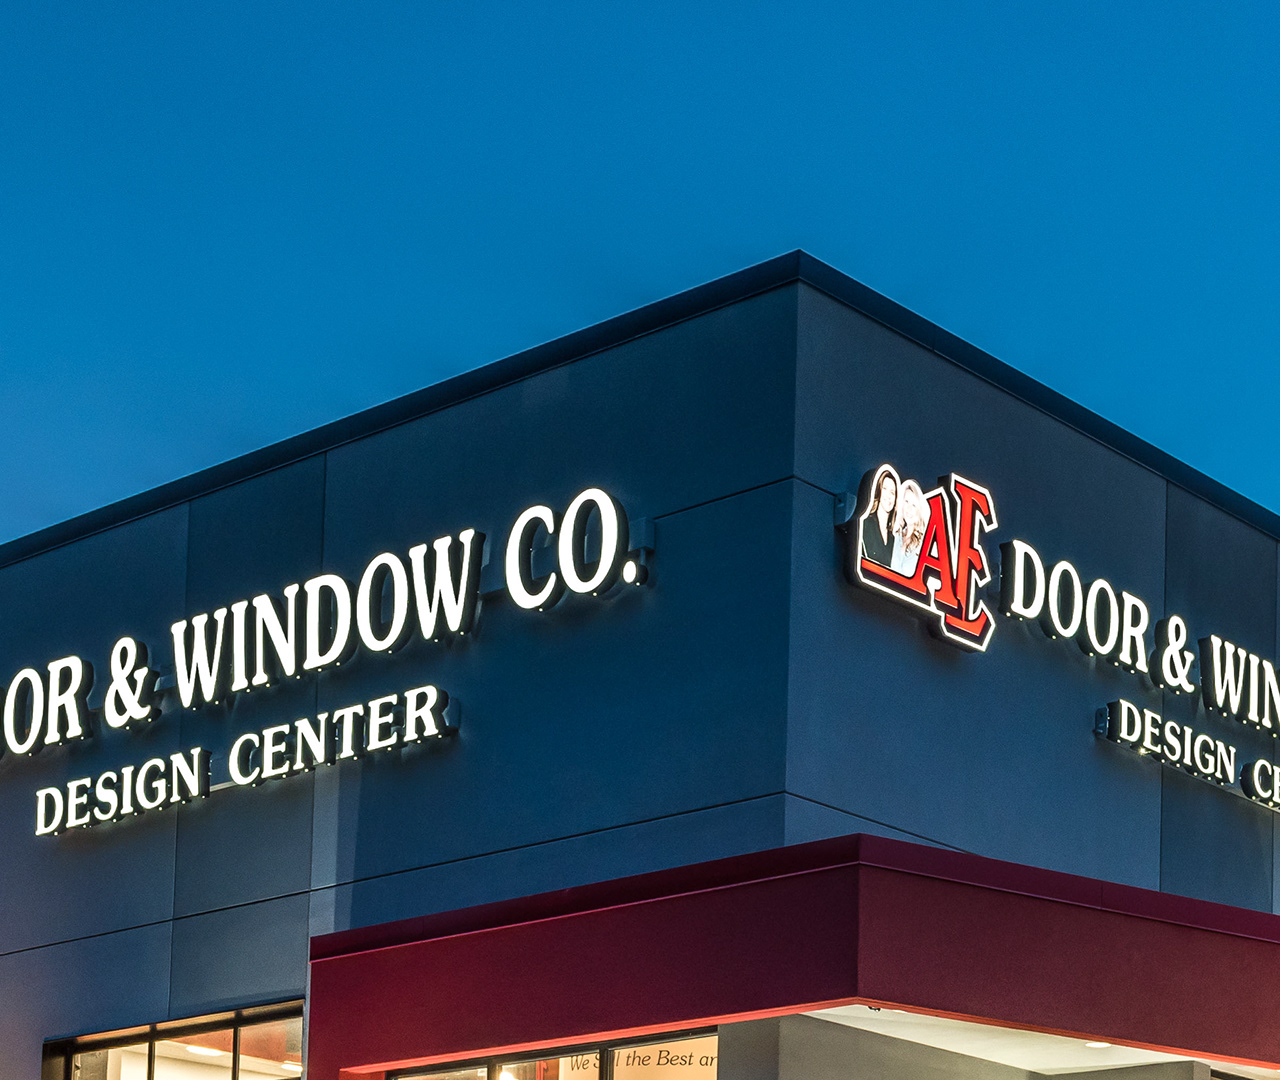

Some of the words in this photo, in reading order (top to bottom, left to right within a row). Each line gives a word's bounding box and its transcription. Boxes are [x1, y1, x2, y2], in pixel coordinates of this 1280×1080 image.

[104, 637, 151, 728] &
[171, 528, 476, 709] WINDOW
[505, 487, 637, 610] CO.
[1010, 539, 1149, 673] DOOR
[1162, 615, 1195, 693] &
[35, 747, 202, 836] DESIGN
[228, 685, 440, 786] CENTER
[1119, 699, 1236, 784] DESIGN
[570, 1055, 590, 1071] We
[626, 1050, 651, 1066] the
[656, 1049, 694, 1067] Best
